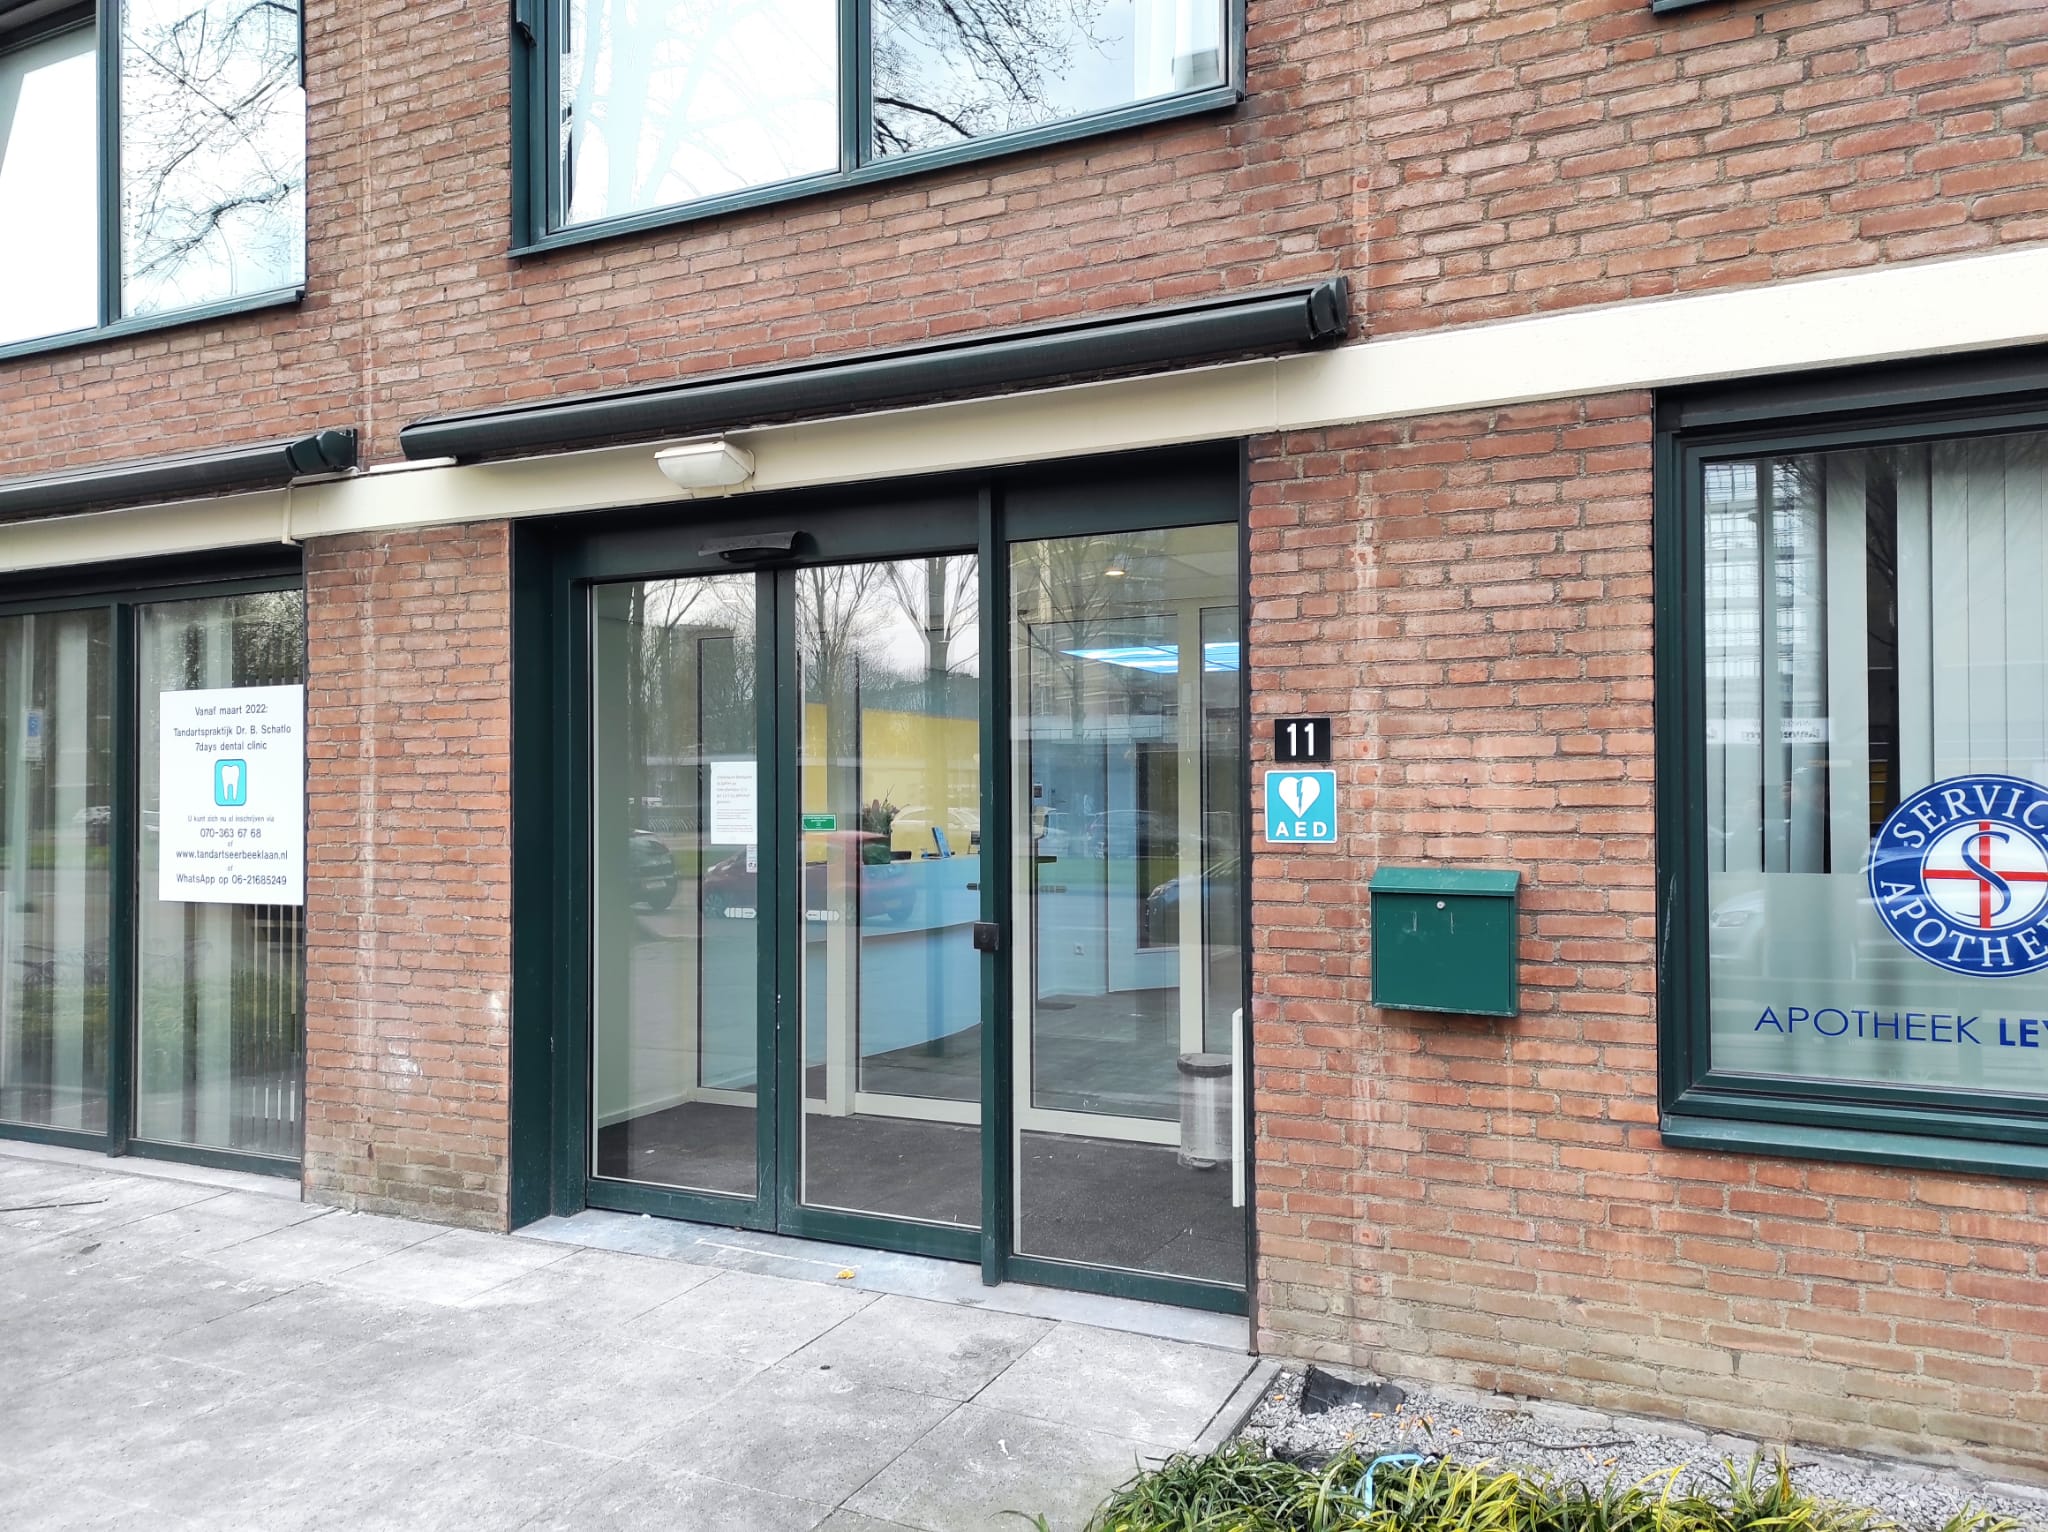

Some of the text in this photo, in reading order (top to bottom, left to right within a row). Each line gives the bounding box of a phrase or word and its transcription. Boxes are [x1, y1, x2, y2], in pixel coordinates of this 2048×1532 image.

[194, 706, 216, 716] Vanaf
[219, 705, 242, 715] maart
[173, 725, 233, 738] Tandartspraktijk
[236, 725, 247, 736] Dr.
[250, 724, 258, 735] B.
[1286, 722, 1315, 757] 11
[195, 740, 267, 753] 7days dental clinic
[1893, 784, 2048, 848] SERVIC
[200, 828, 262, 838] 070-363 67 68
[1275, 821, 1328, 837] AED
[176, 849, 288, 860] www.tandartseerbeeklaan.nl
[176, 873, 215, 886] WhatsApp
[218, 876, 229, 886] op
[1754, 1006, 2048, 1048] APOTHEEK LE
